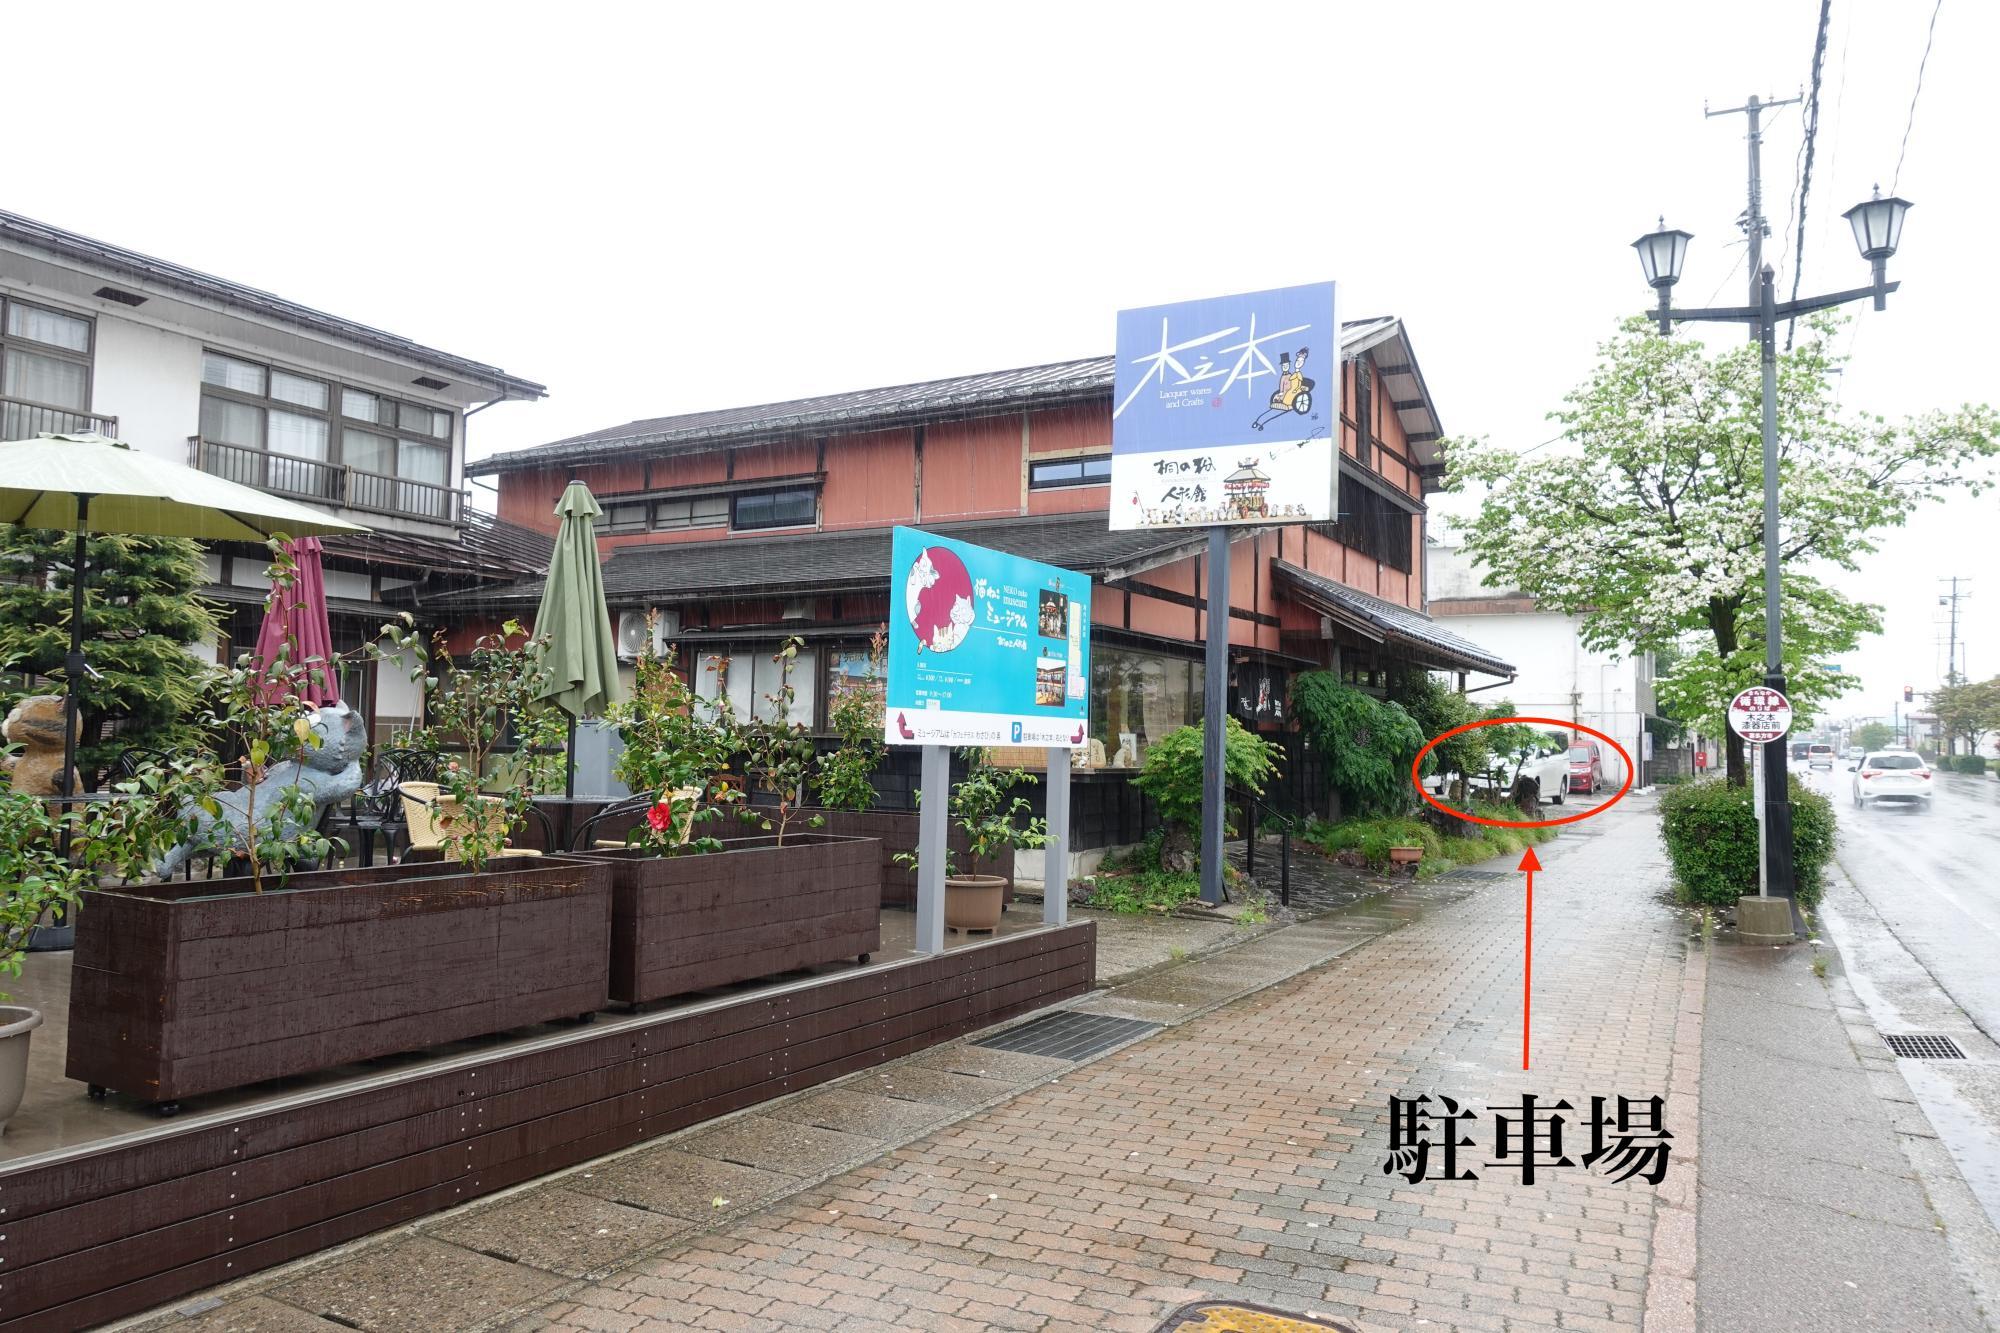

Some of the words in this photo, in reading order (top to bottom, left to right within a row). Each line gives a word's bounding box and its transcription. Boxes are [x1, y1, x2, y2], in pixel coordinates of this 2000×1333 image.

[1114, 312, 1311, 419] 木之本
[1159, 390, 1188, 400] Lacquer
[1165, 399, 1180, 409] and
[1181, 397, 1205, 407] Crafts
[1160, 484, 1207, 503] 人形館
[1003, 596, 1028, 609] museum
[986, 600, 1027, 629] ミュージアム
[1740, 696, 1779, 706] 循環線
[1746, 713, 1776, 722] 木之本
[1014, 724, 1020, 739] P
[1741, 721, 1781, 730] 漆器店前
